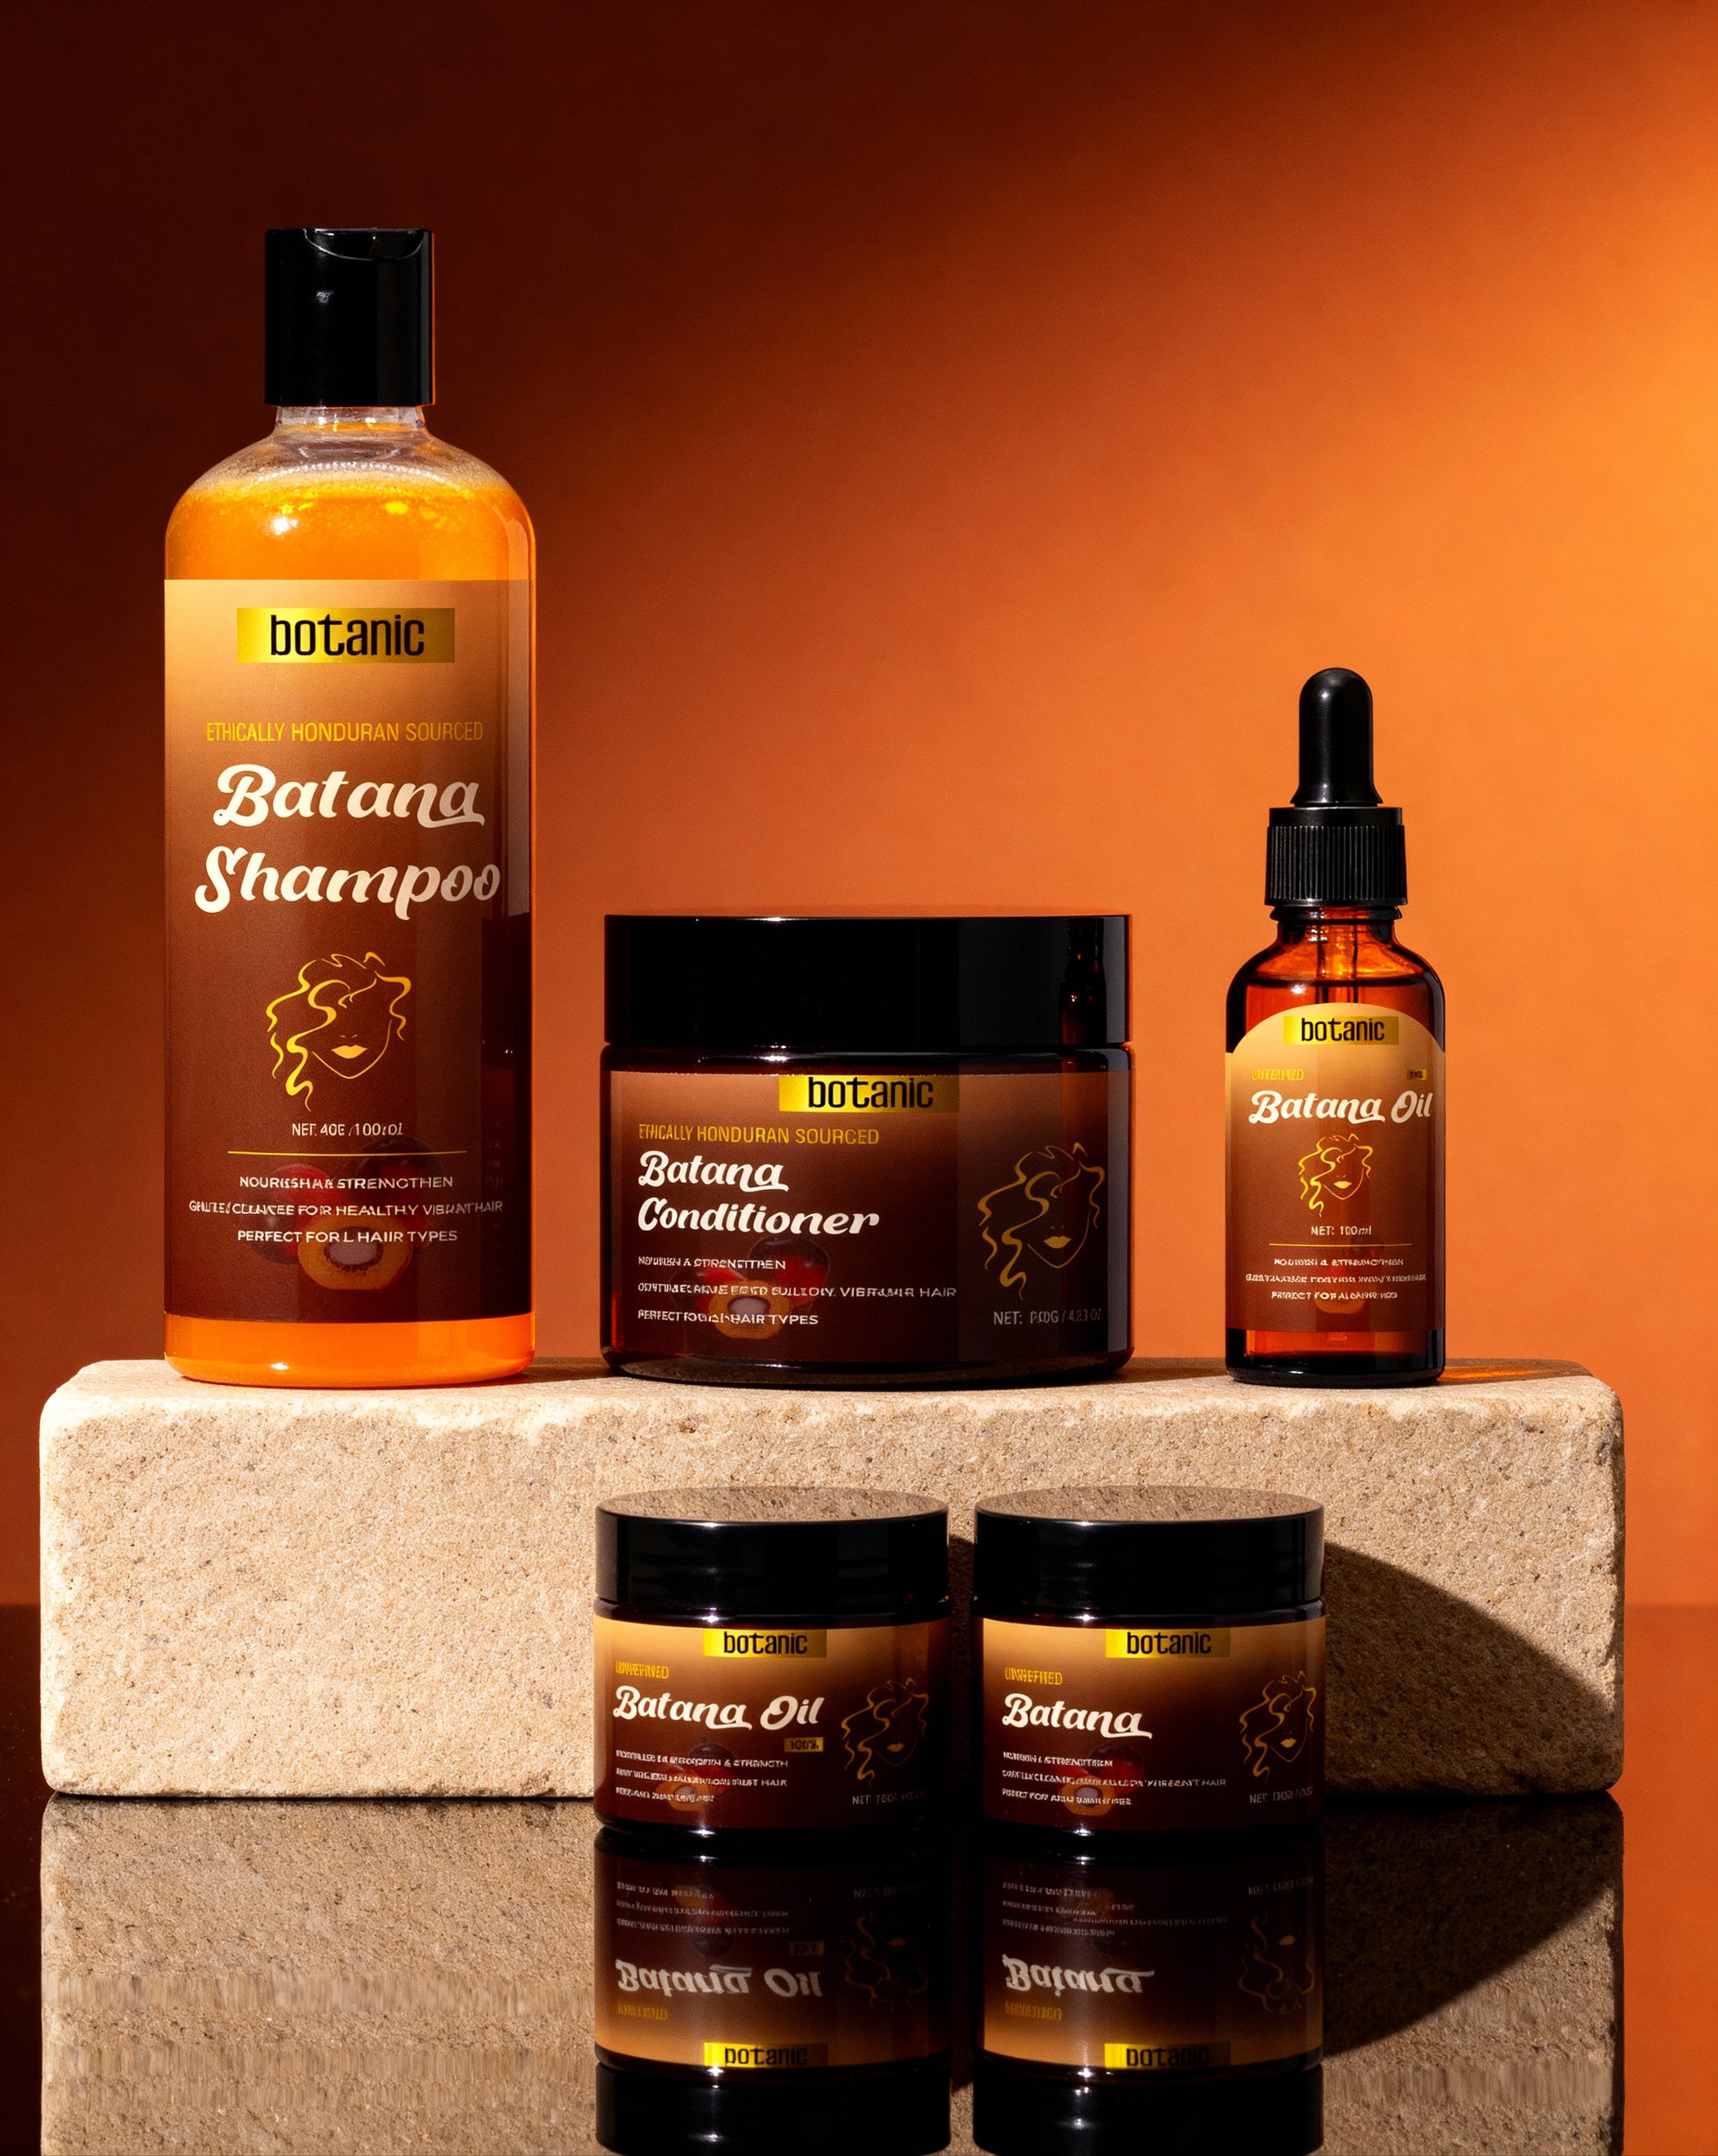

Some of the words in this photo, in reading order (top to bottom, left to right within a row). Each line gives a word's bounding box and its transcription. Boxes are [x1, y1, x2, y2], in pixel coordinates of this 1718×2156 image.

[270, 614, 425, 656] botanic
[206, 722, 284, 742] ETHICALLY
[291, 722, 399, 742] HONDURAN
[405, 721, 483, 742] SOURCED
[213, 764, 486, 829] Batana
[194, 845, 501, 921] Shampoo
[1300, 1017, 1385, 1043] botanic
[808, 1076, 934, 1109] botanic
[1248, 1089, 1386, 1125] Batana
[1390, 1089, 1434, 1124] Oil
[638, 1124, 694, 1142] ETHICALLY
[697, 1126, 790, 1144] HONDURAN
[795, 1128, 880, 1145] SOURCED
[638, 1150, 789, 1193] Batana
[637, 1196, 880, 1235] Conditioner
[237, 1229, 303, 1242] PERFECT
[305, 1231, 340, 1243] FOR
[406, 1230, 458, 1242] TYPES
[919, 1286, 957, 1298] HAIR
[993, 1310, 1023, 1325] NET:
[723, 1631, 808, 1655] botanic
[1126, 1631, 1212, 1655] botanic
[613, 1685, 753, 1730] Batana
[759, 1694, 825, 1731] Oil
[1002, 1692, 1153, 1740] Batana
